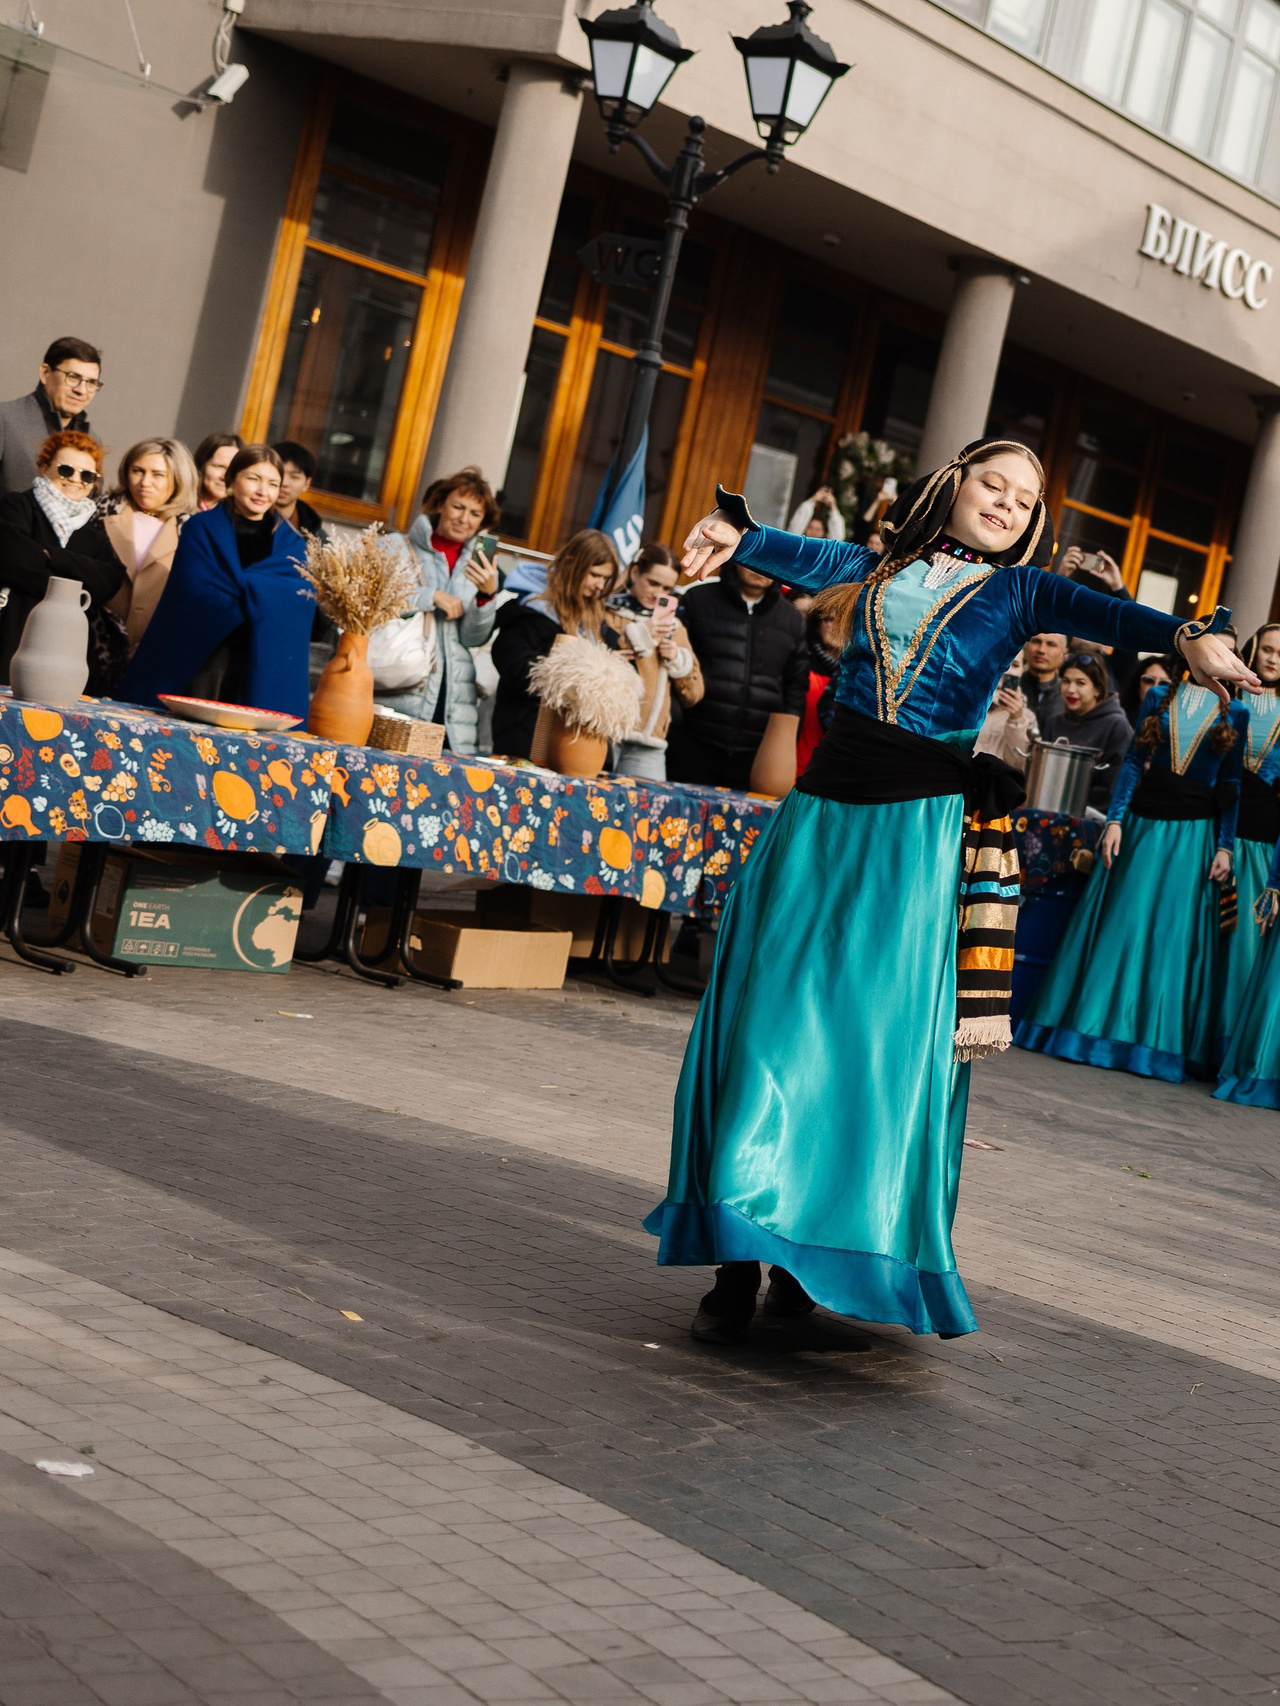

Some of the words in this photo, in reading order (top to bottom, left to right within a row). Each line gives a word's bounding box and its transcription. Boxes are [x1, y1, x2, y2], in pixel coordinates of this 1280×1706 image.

[596, 241, 659, 280] WC
[1140, 202, 1273, 310] БЛИСС
[129, 910, 171, 930] 1EA
[133, 901, 148, 909] ONE
[148, 903, 170, 911] EARTH
